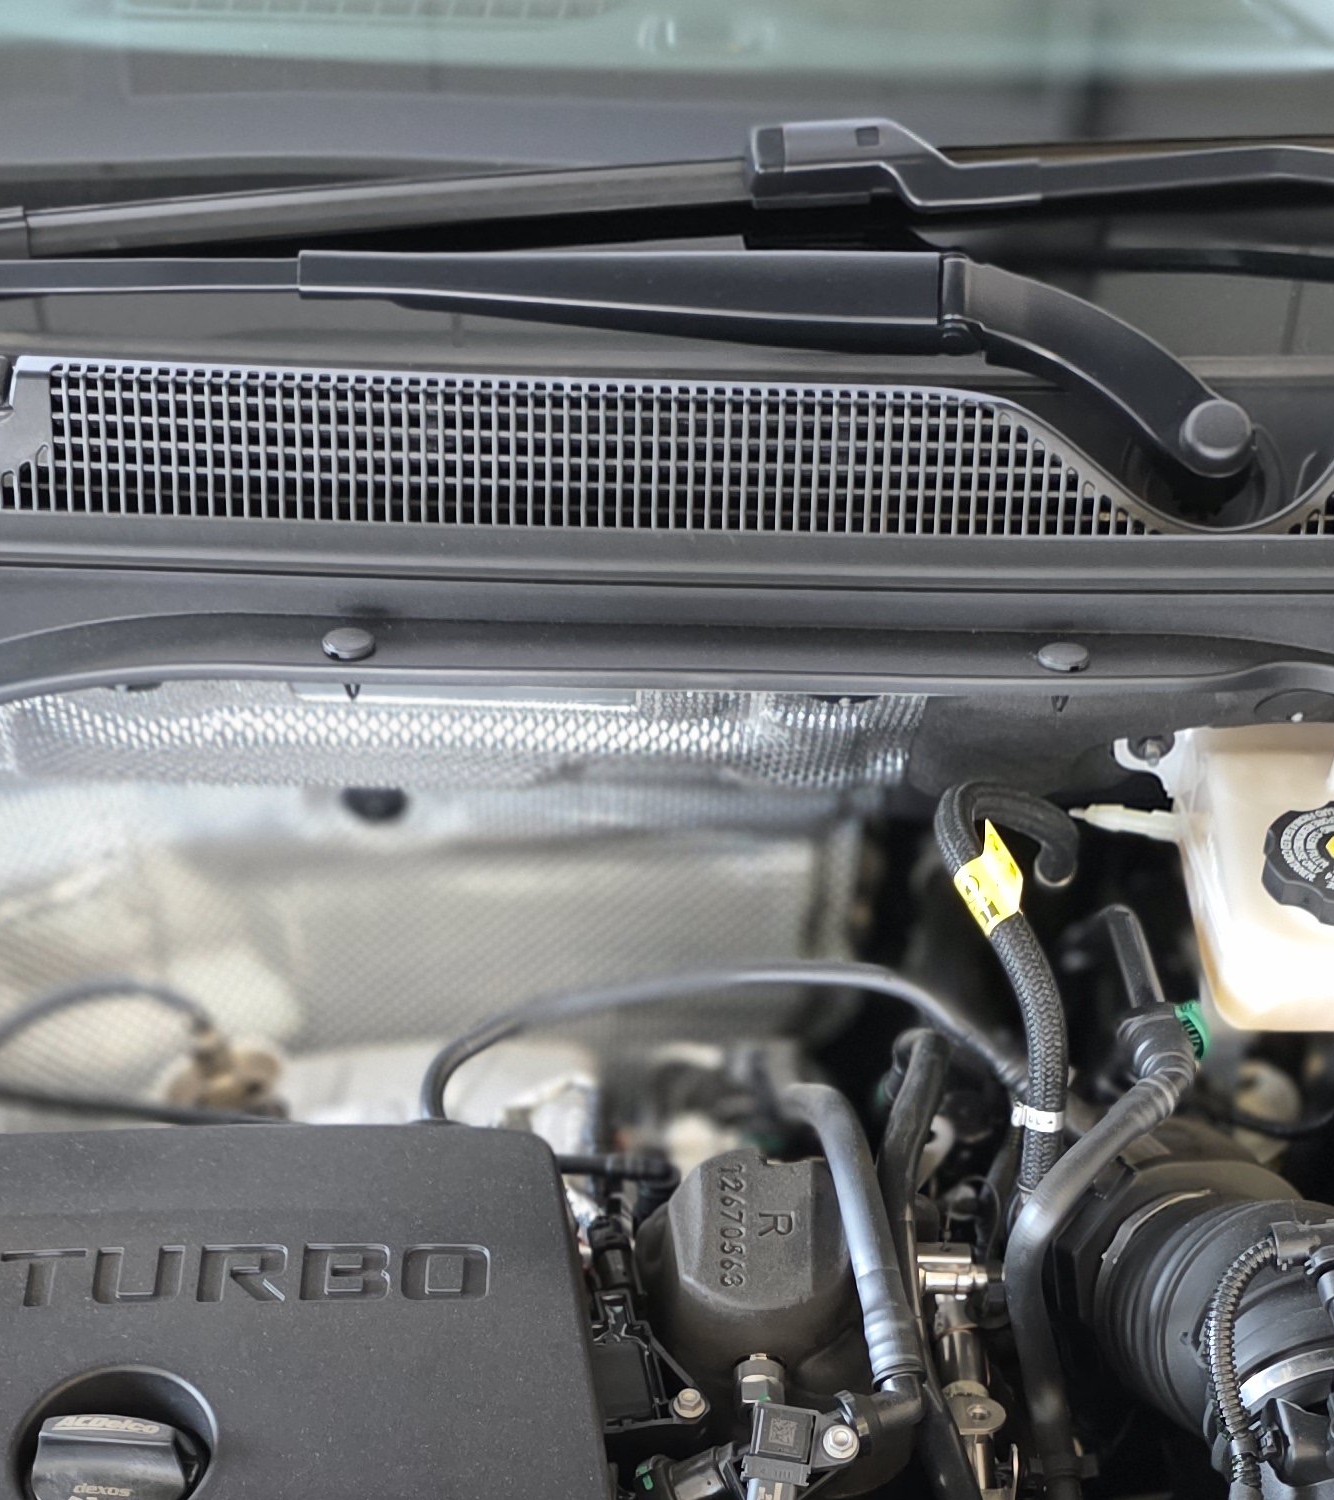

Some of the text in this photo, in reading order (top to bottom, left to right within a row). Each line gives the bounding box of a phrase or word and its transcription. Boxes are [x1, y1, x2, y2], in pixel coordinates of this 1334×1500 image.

[758, 1212, 793, 1237] R
[0, 1243, 492, 1308] TURBO
[52, 1416, 160, 1434] ACDelco
[73, 1482, 131, 1497] dexos
